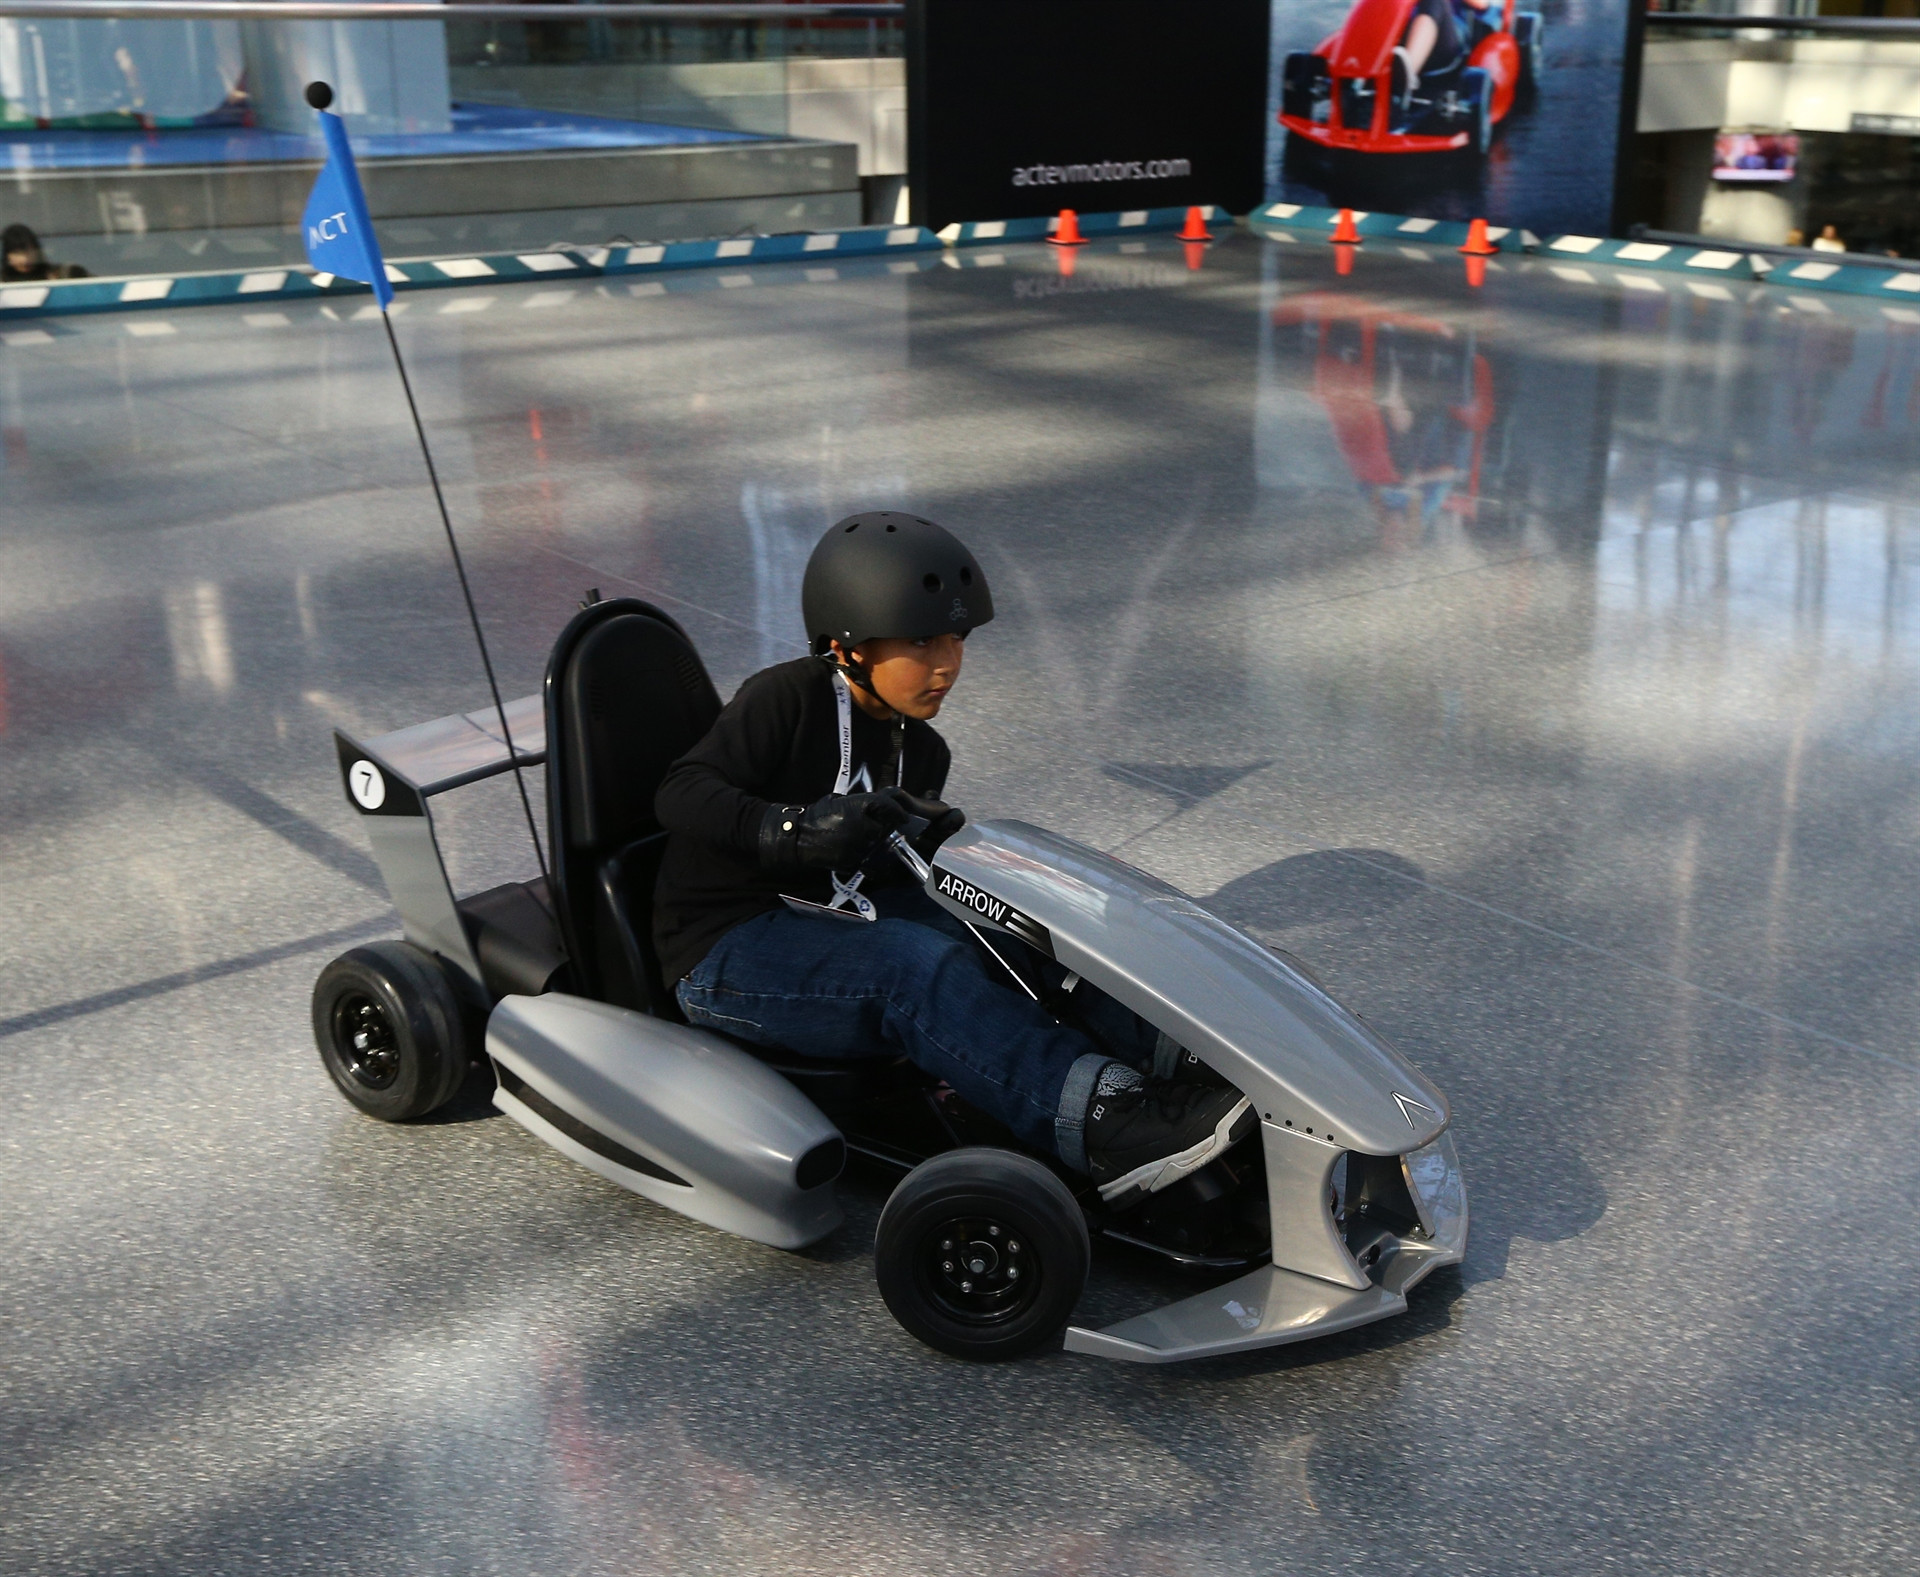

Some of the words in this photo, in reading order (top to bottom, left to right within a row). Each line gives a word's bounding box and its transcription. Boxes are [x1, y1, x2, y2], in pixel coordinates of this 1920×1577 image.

[1012, 158, 1191, 187] actevmotors.com
[841, 725, 850, 777] Member
[361, 771, 372, 797] 7
[938, 874, 1007, 921] ARROW
